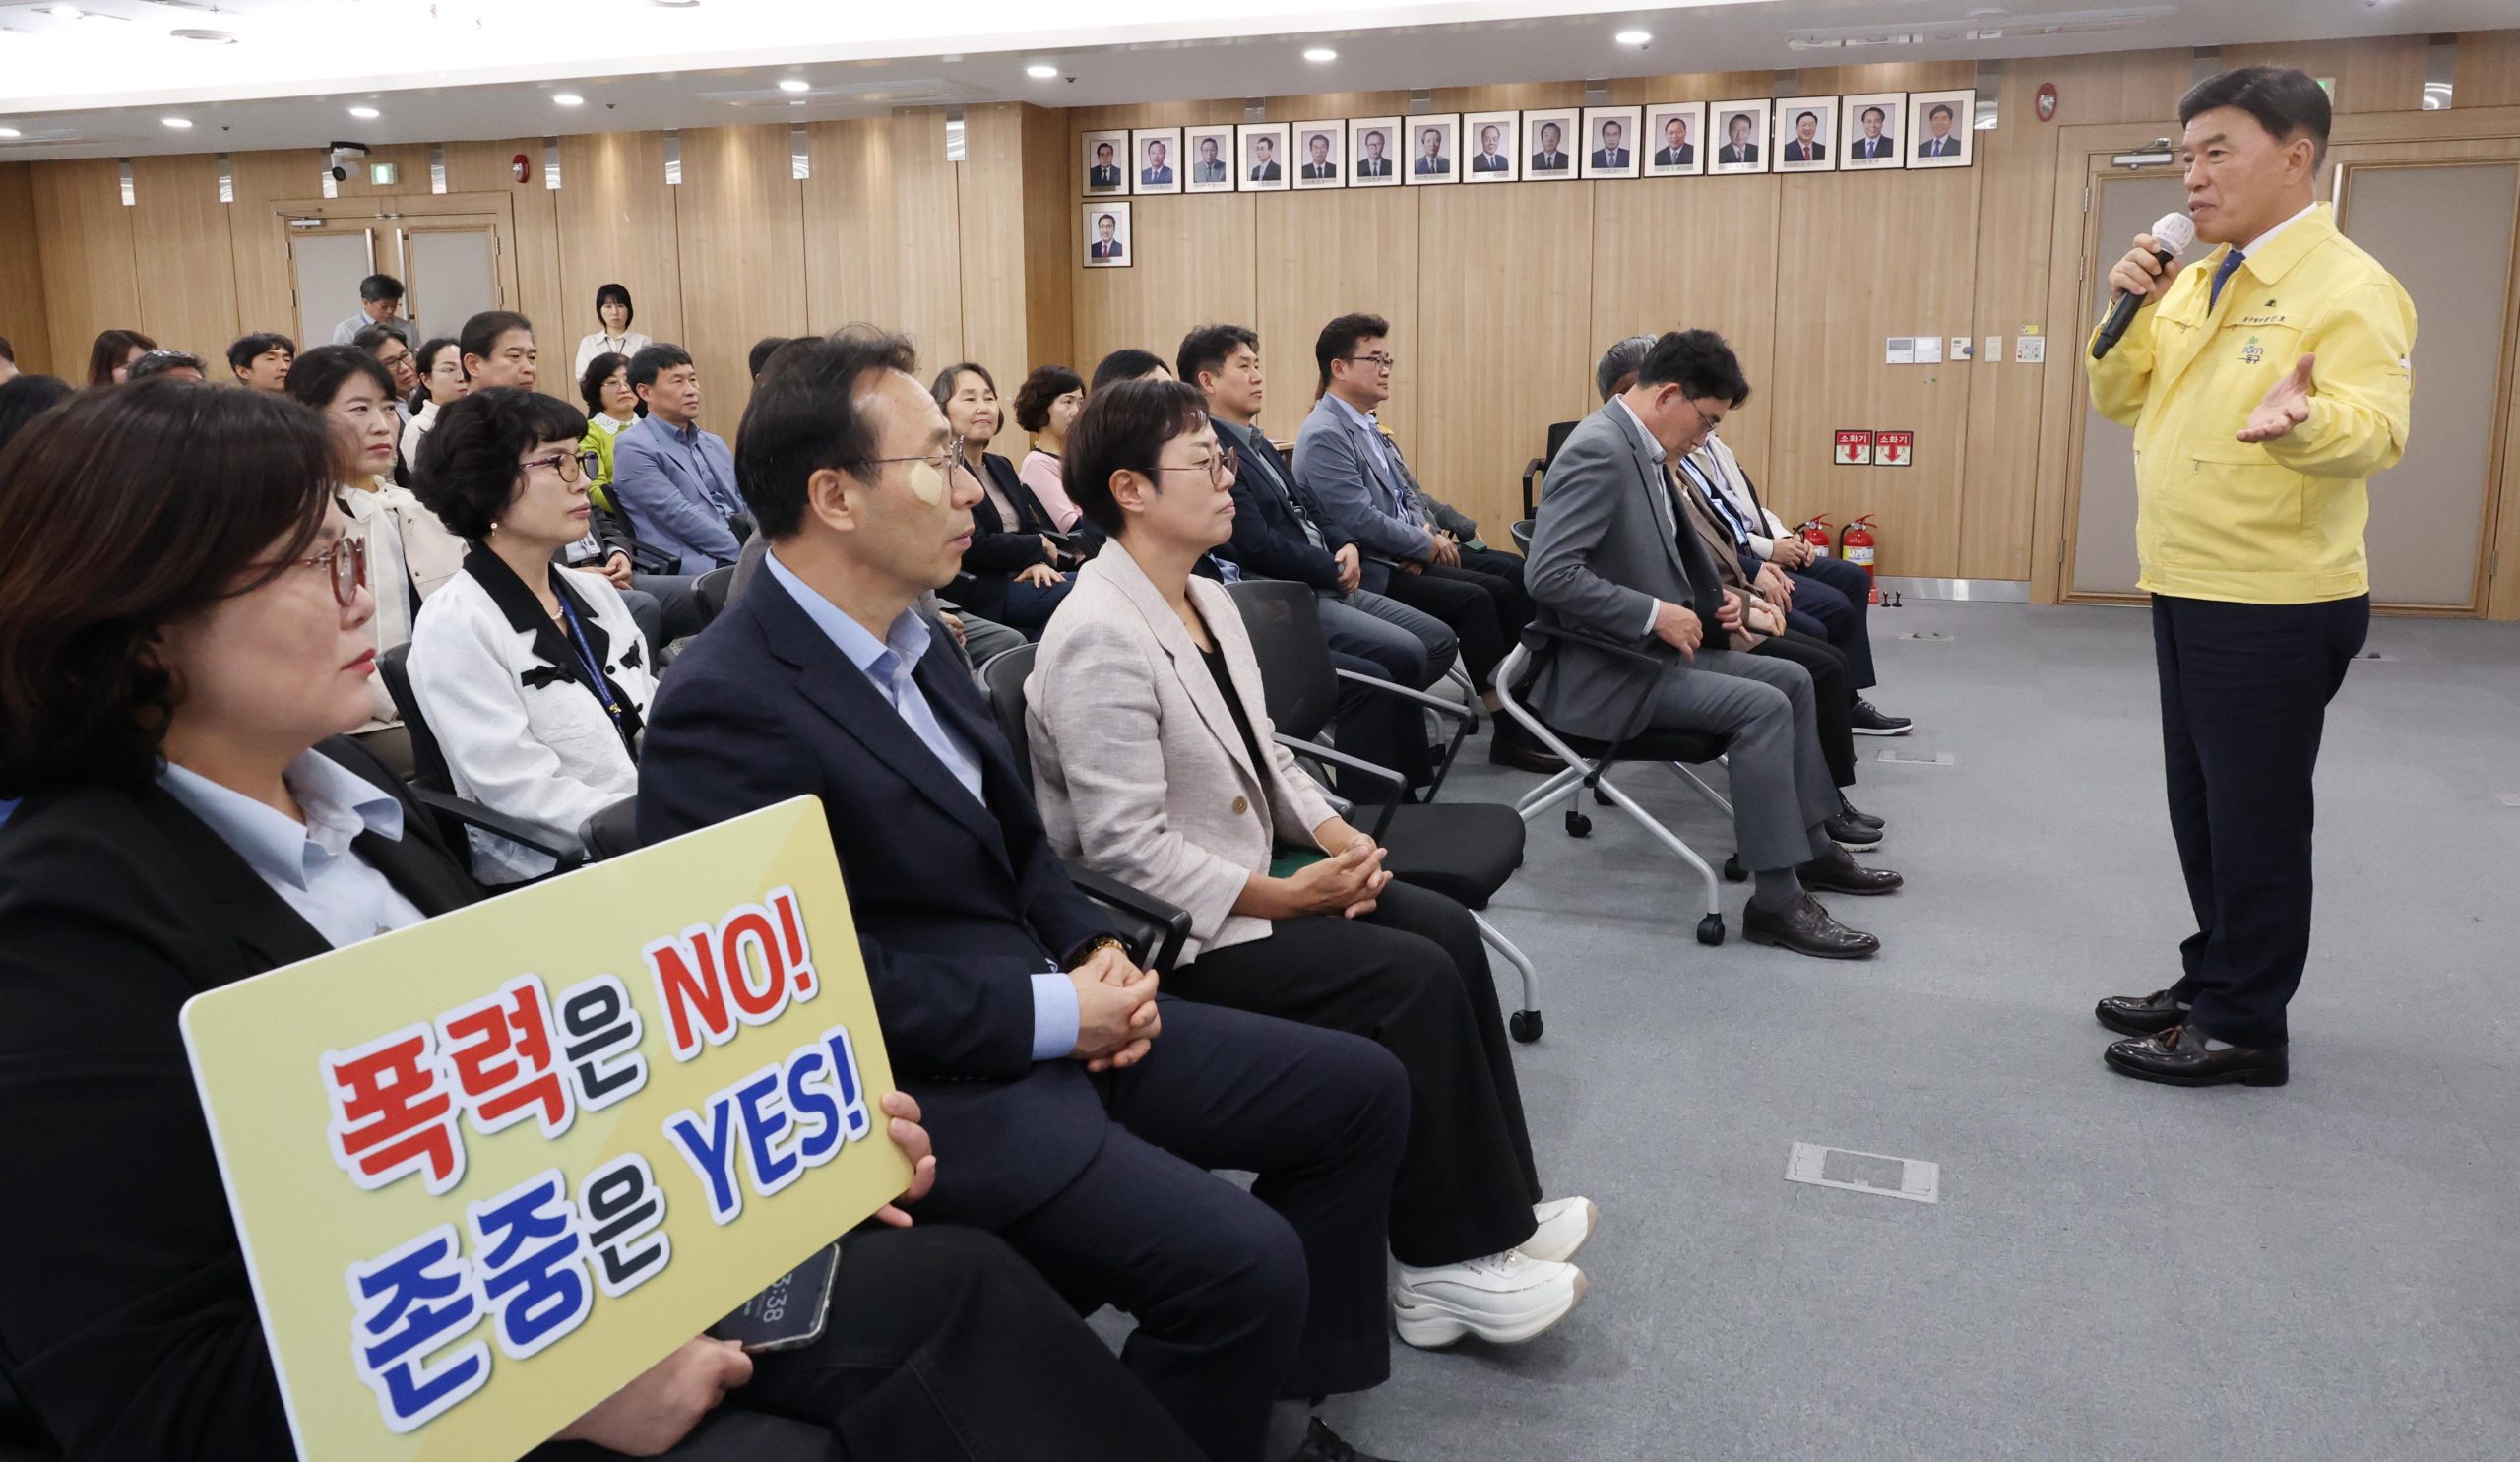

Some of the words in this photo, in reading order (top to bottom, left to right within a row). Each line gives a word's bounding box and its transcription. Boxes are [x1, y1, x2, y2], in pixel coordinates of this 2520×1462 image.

[1839, 434, 1867, 443] 소화기
[1879, 435, 1908, 444] 소화기
[331, 982, 641, 1184] 폭력은
[650, 893, 813, 1053] NO!
[356, 1163, 663, 1420] 존중은
[670, 1033, 867, 1217] YES!
